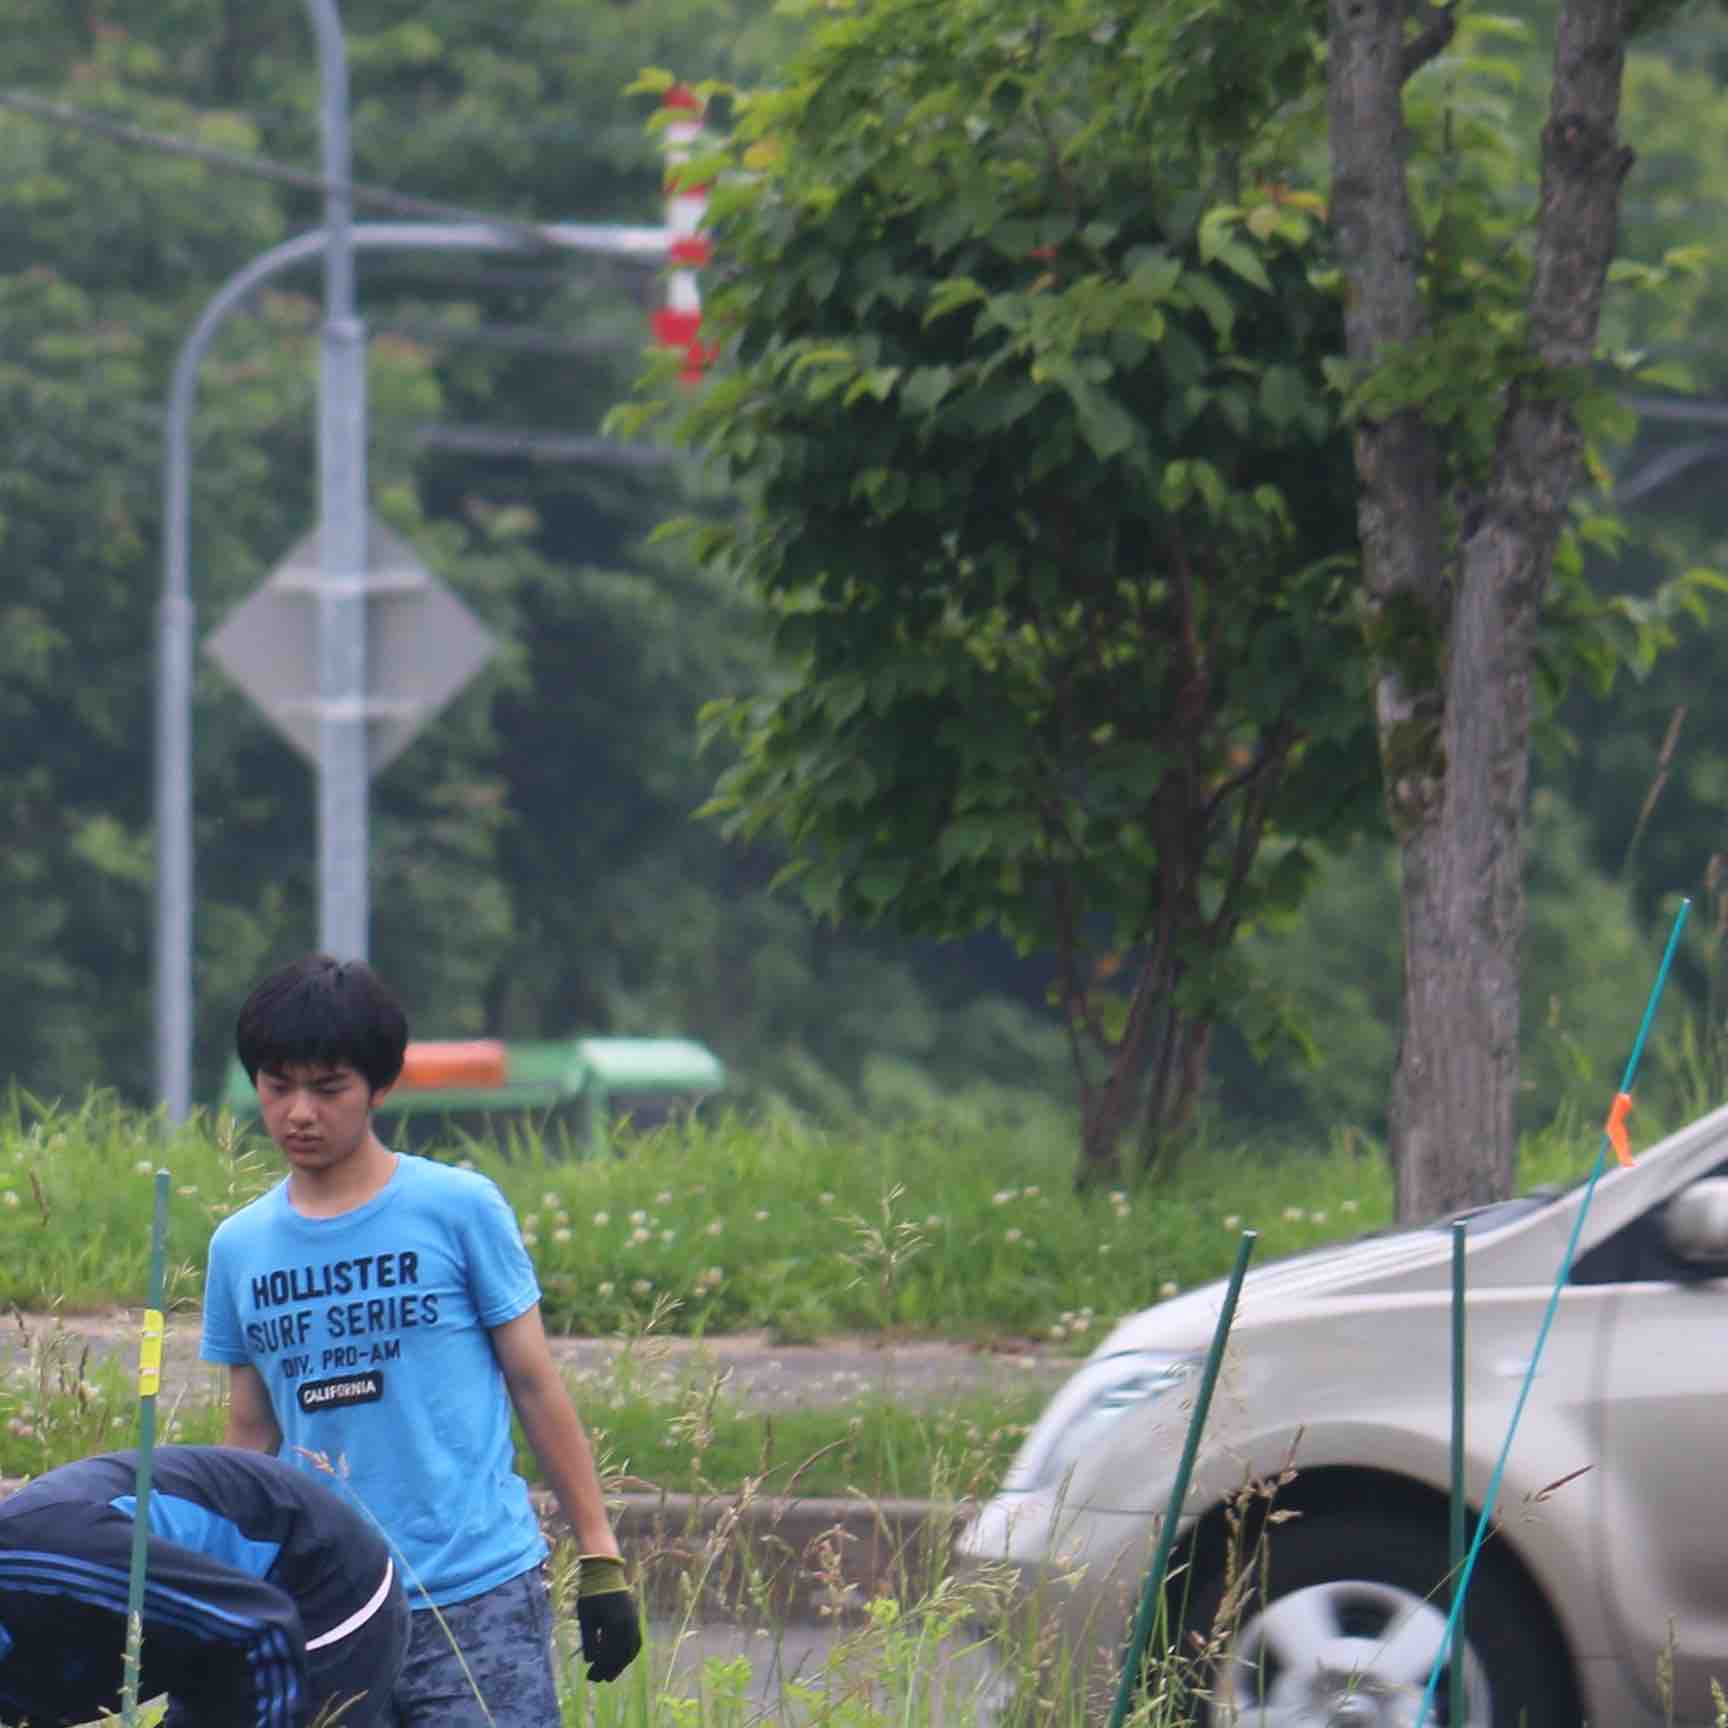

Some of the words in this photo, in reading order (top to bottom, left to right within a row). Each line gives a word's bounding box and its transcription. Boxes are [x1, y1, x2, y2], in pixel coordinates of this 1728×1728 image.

[252, 1251, 419, 1310] HOLLISTER
[246, 1310, 313, 1353] SURF
[326, 1294, 439, 1338] SERIES
[281, 1355, 314, 1378] DIV.
[321, 1339, 401, 1371] PRO-AM
[303, 1379, 377, 1404] CALIFORNIA
